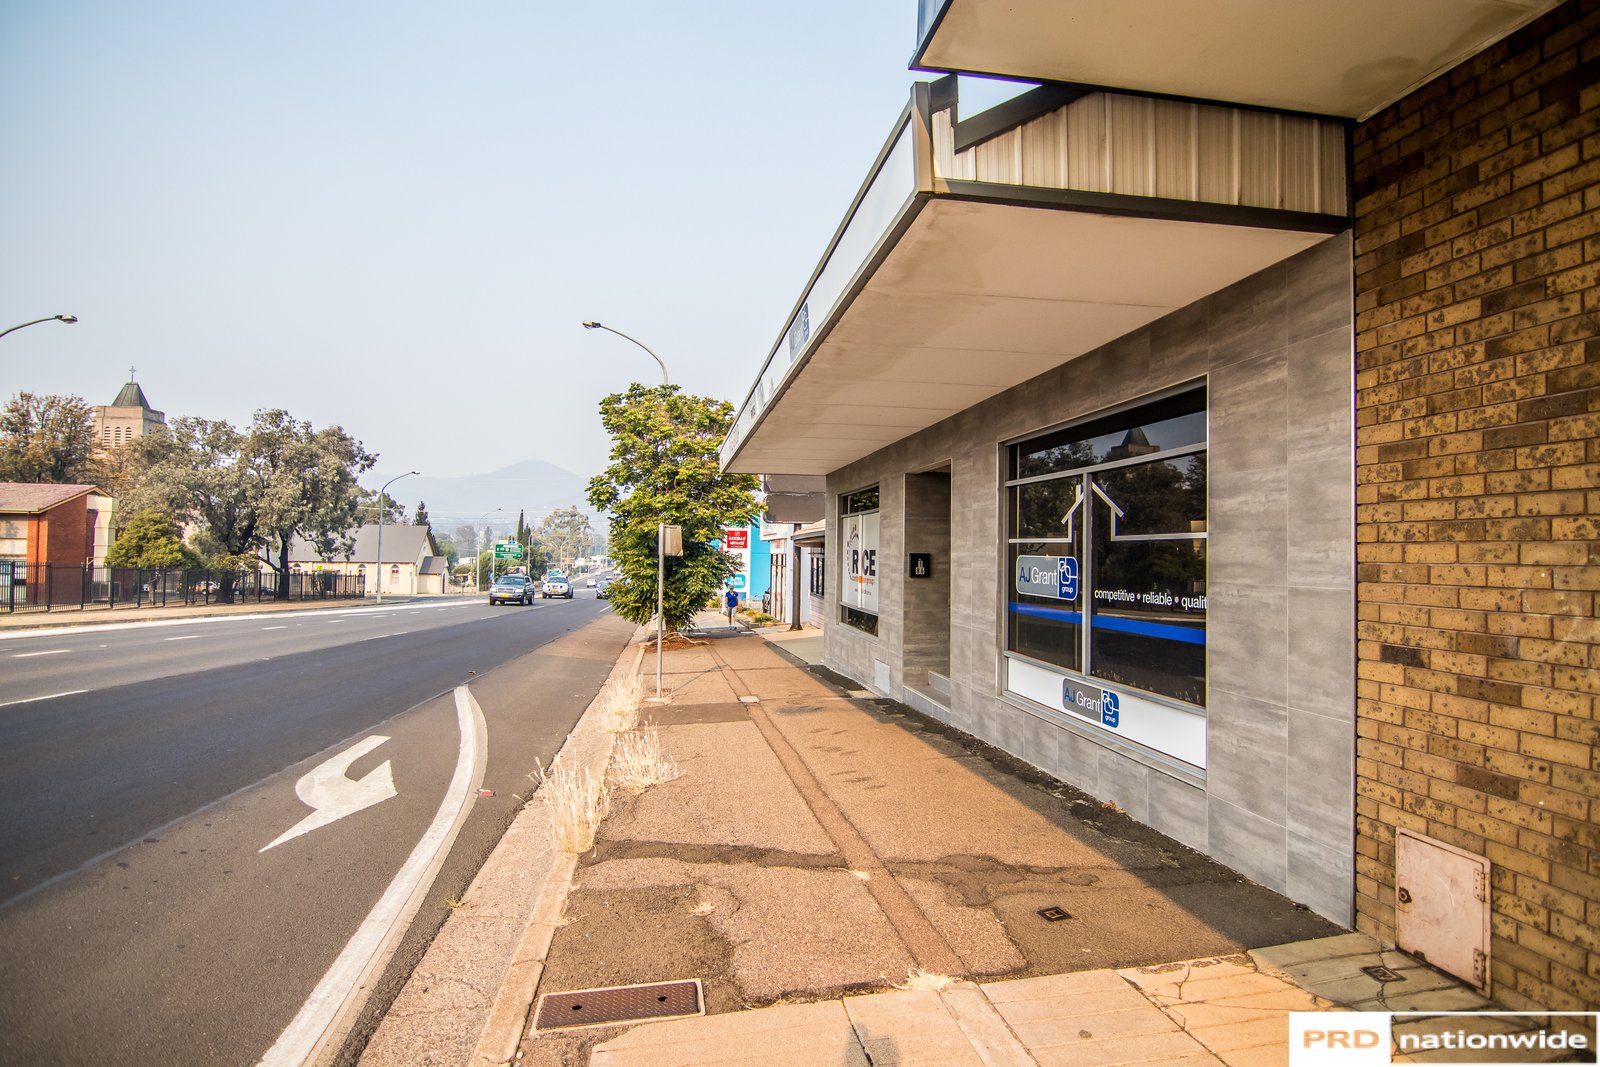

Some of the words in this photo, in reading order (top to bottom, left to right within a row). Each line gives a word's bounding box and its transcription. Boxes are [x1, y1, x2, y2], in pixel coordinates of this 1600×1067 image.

[852, 549, 876, 576] RCE
[1031, 566, 1057, 586] Grant
[1094, 589, 1135, 602] competitive
[1142, 591, 1172, 606] reliable
[1076, 690, 1101, 713] Grant
